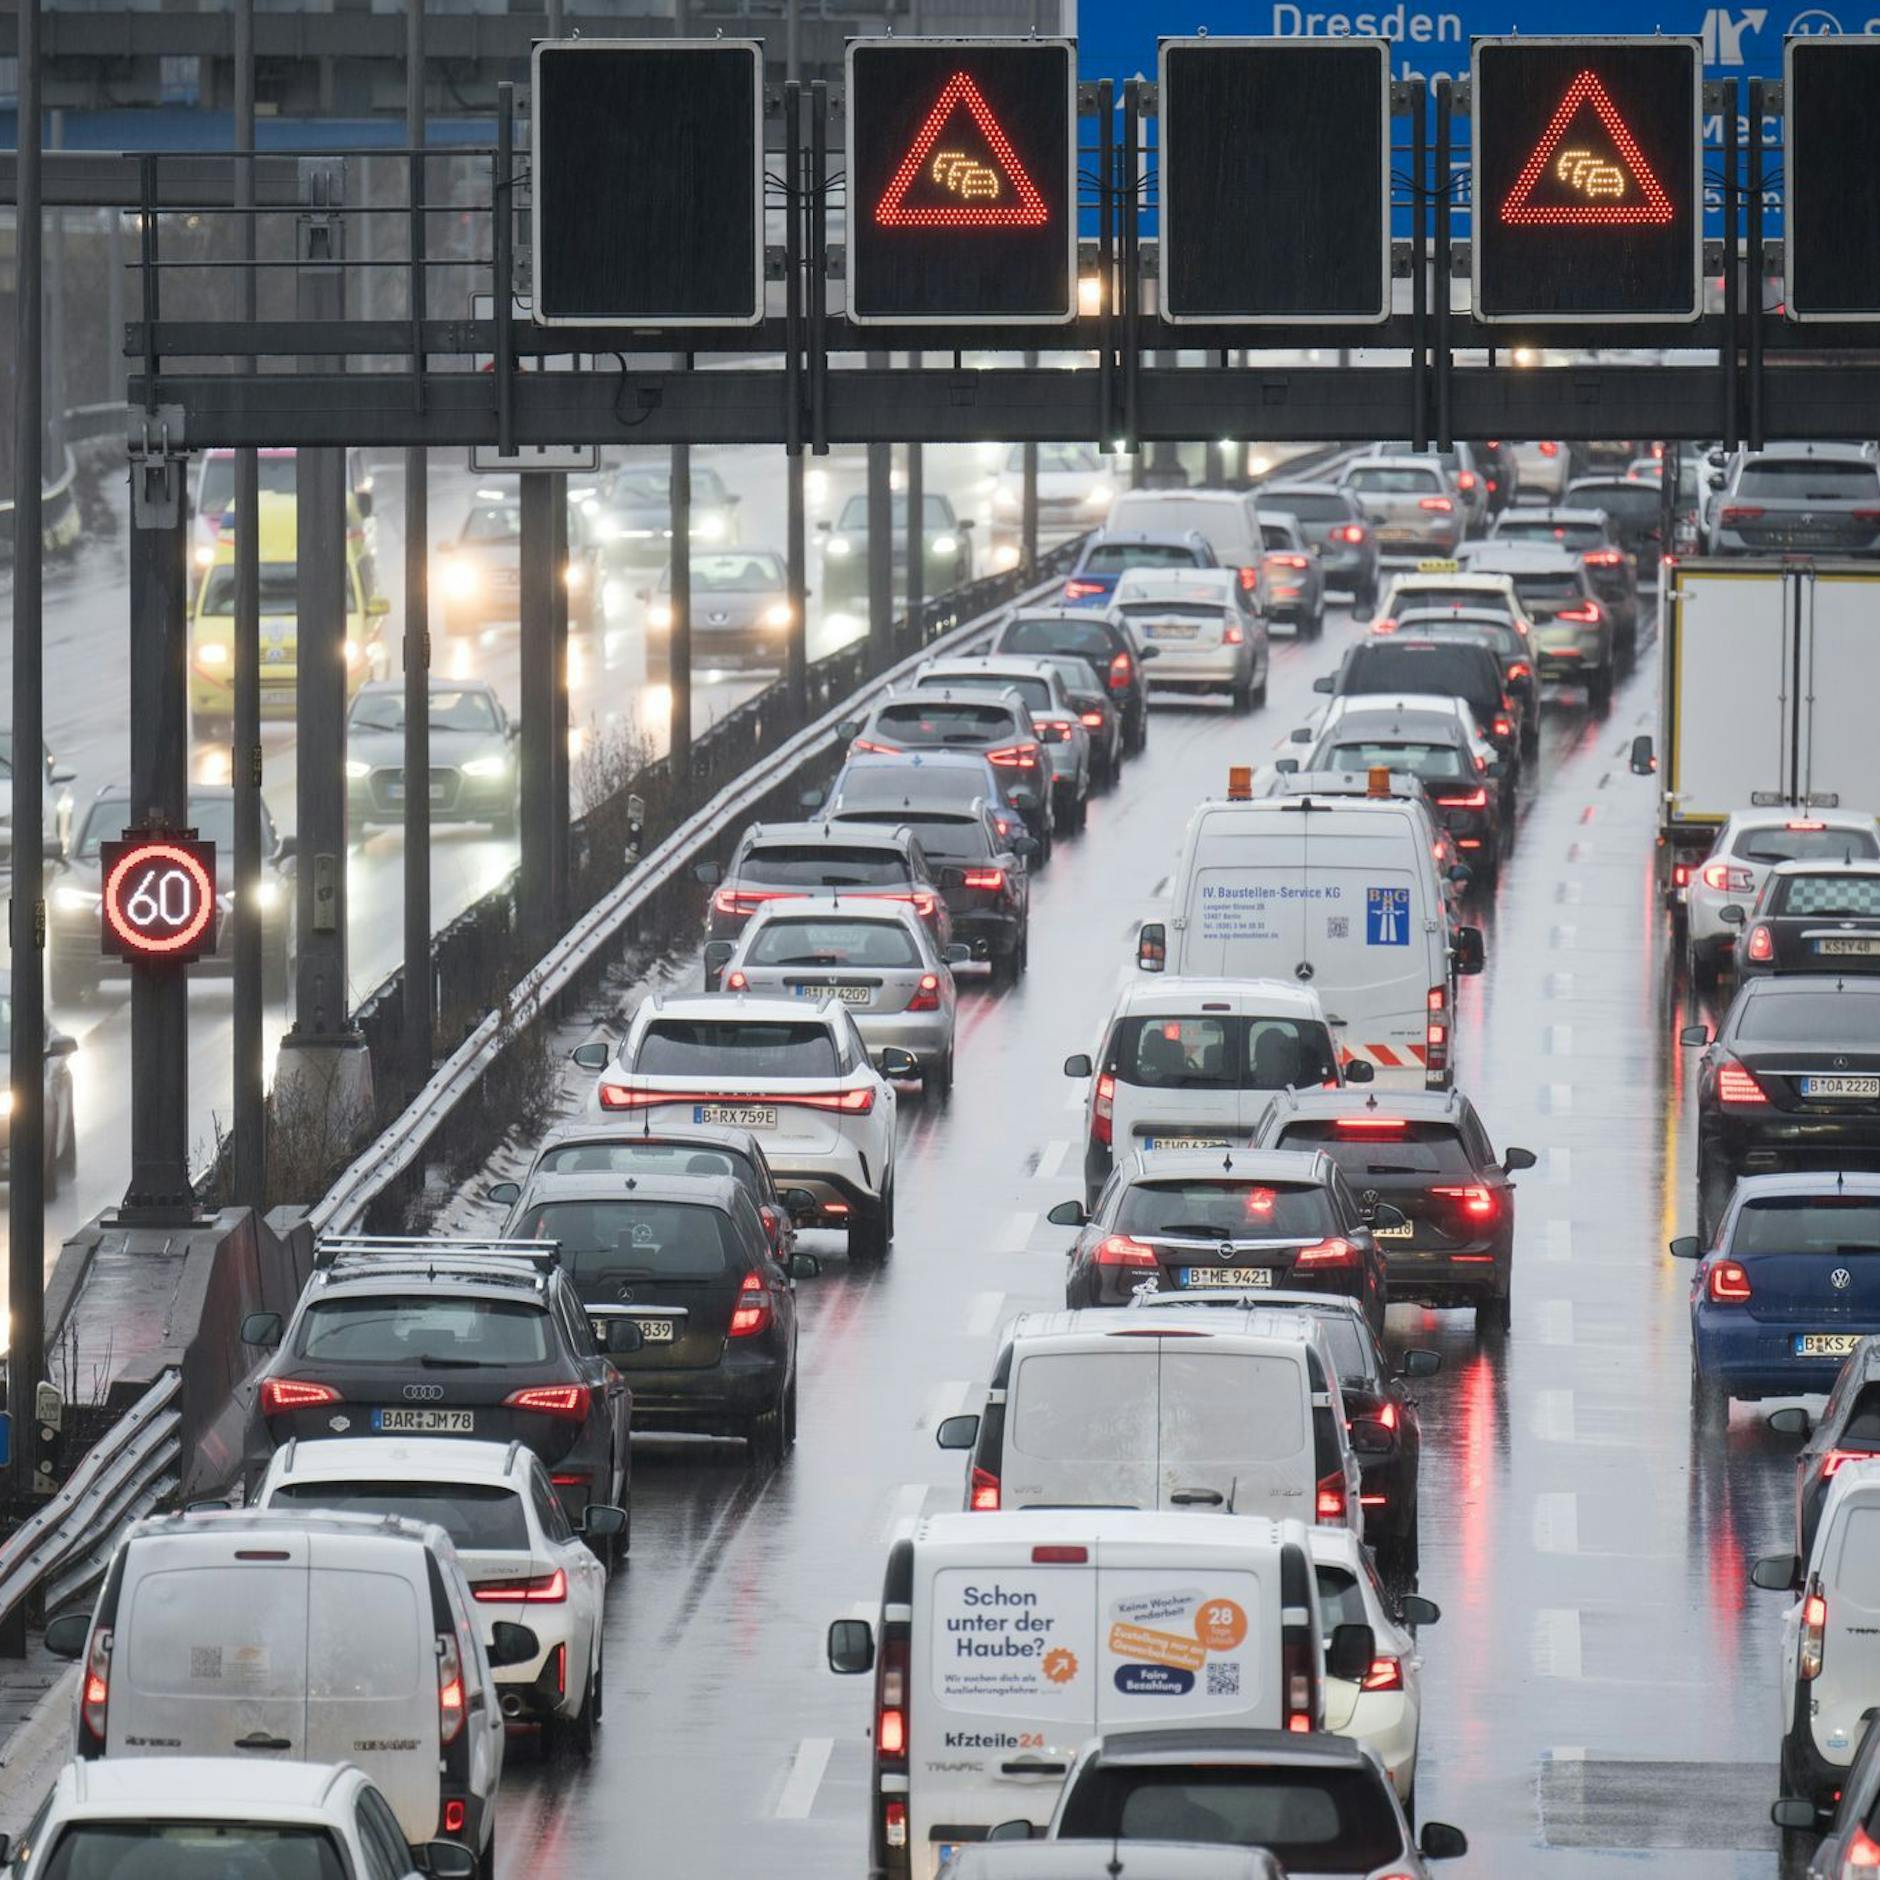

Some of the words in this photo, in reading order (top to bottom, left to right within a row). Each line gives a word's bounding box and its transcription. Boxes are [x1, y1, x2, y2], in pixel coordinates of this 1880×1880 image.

[1273, 4, 1462, 42] Dresden
[127, 869, 190, 925] 60
[1325, 886, 1341, 899] KG
[838, 988, 867, 1001] 4209
[1810, 1080, 1818, 1092] B
[1846, 1080, 1878, 1092] 2228
[703, 1111, 712, 1123] B
[719, 1111, 737, 1123] RX
[740, 1111, 775, 1124] 759E
[1191, 1270, 1200, 1282] B
[1209, 1270, 1229, 1283] ME
[1233, 1270, 1270, 1284] 9421
[1805, 1337, 1814, 1350] B
[1824, 1337, 1844, 1350] KS
[382, 1412, 415, 1428] BAR
[426, 1413, 448, 1428] JM
[450, 1413, 472, 1429] 78
[963, 1584, 1037, 1606] Schon
[947, 1614, 1009, 1632] unter
[1015, 1610, 1055, 1632] der
[1208, 1607, 1233, 1625] 28
[957, 1635, 1045, 1657] Haube?
[1141, 1669, 1168, 1680] Faire
[1126, 1680, 1183, 1693] Bezahlung
[945, 1732, 1045, 1748] kfzteile24
